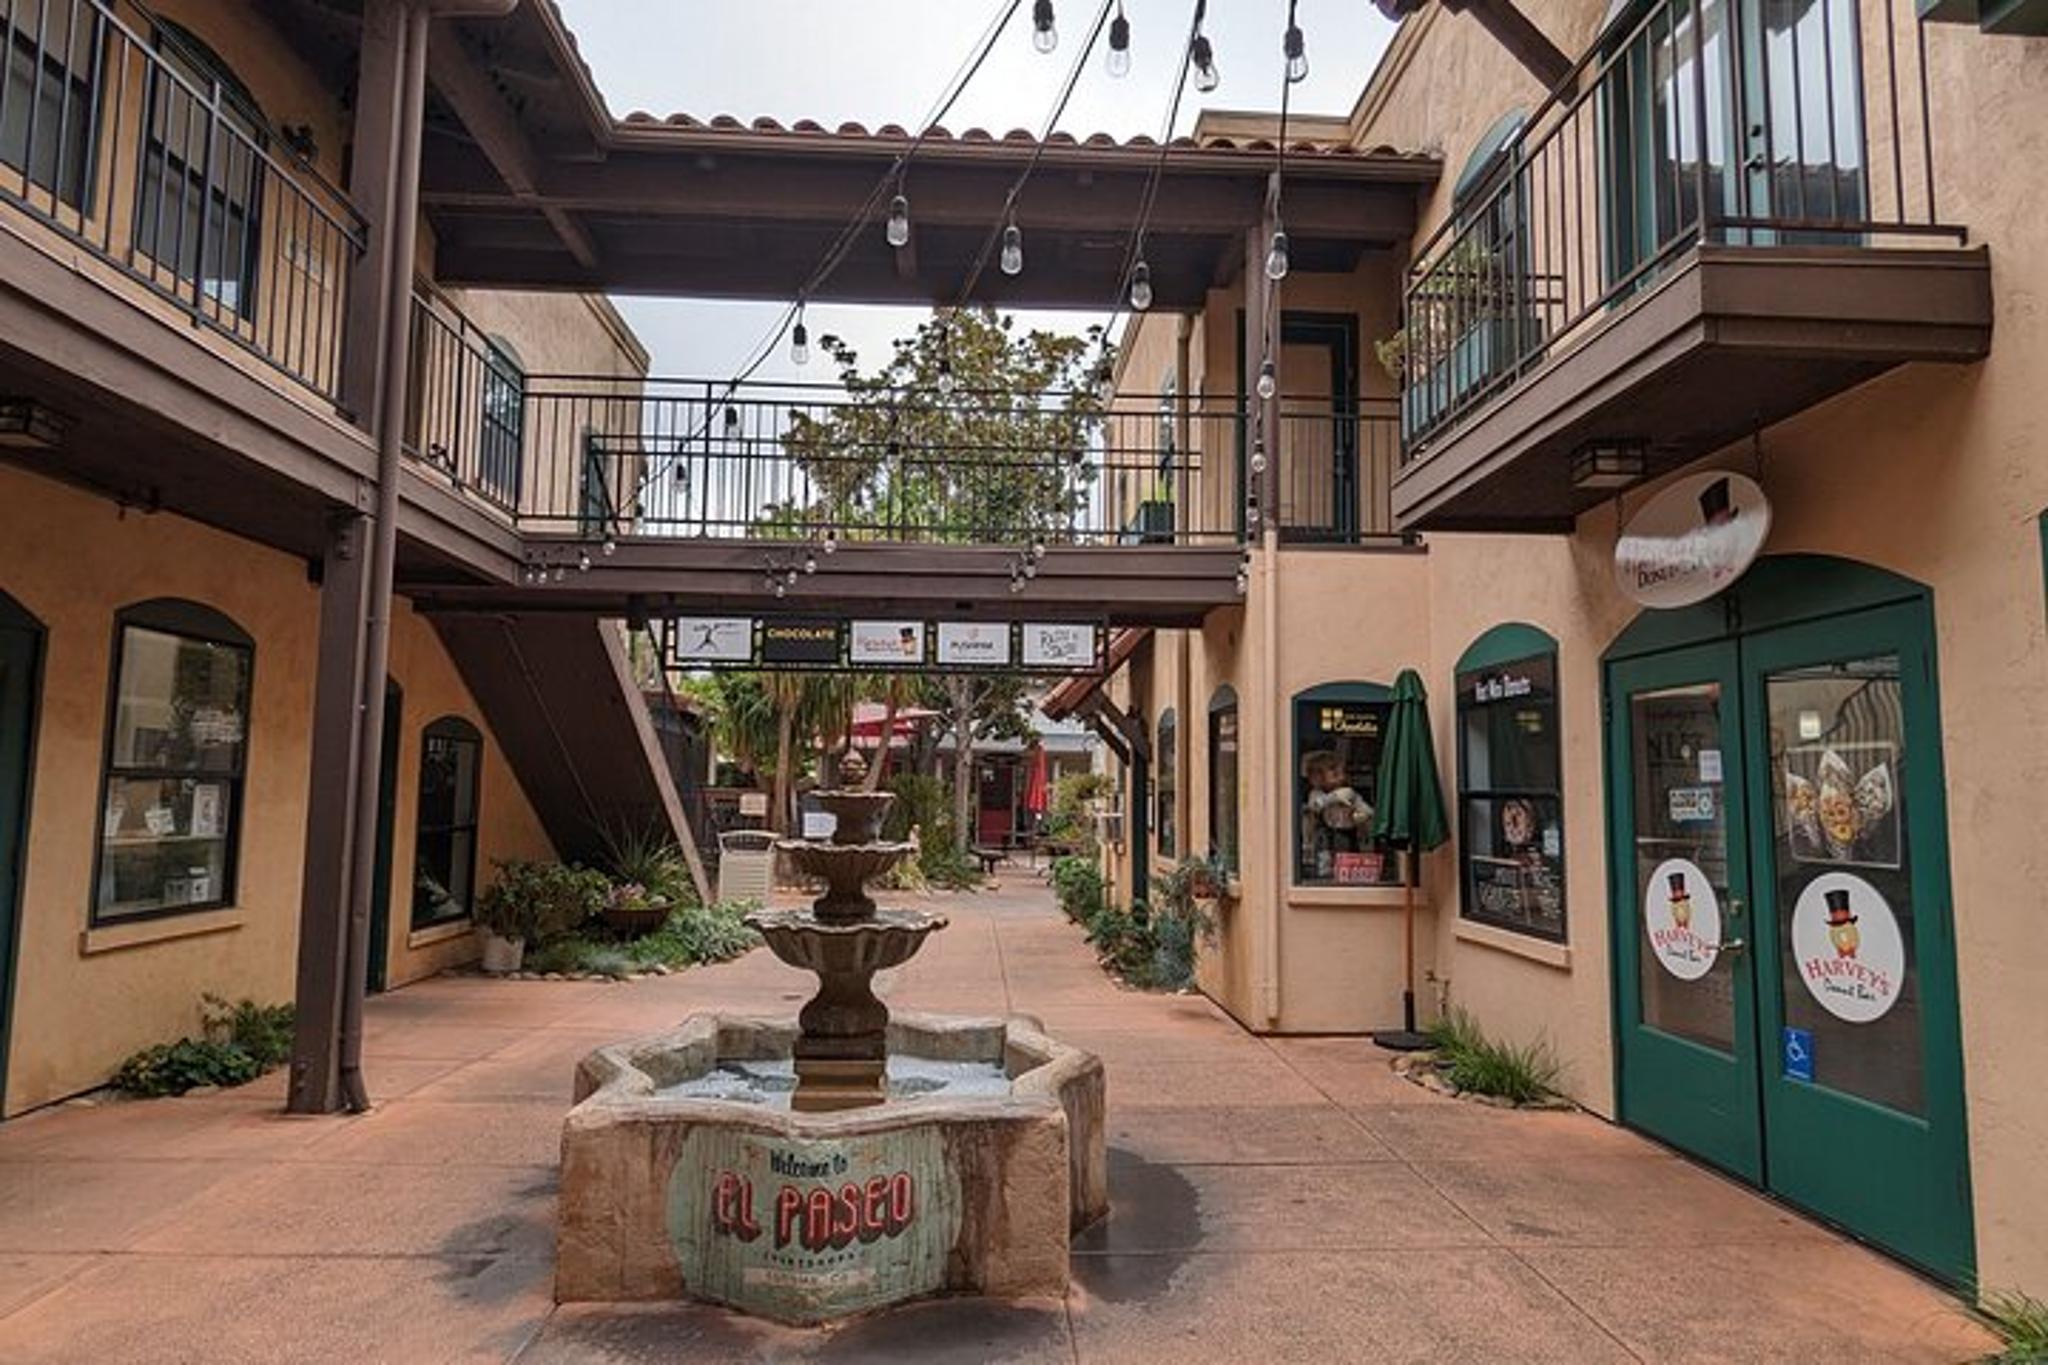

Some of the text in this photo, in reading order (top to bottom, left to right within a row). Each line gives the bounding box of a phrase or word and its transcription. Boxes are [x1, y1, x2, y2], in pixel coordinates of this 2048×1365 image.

[767, 628, 836, 639] CHOCOLATE
[770, 1149, 829, 1178] Welcome
[712, 1170, 914, 1254] EL PASEO
